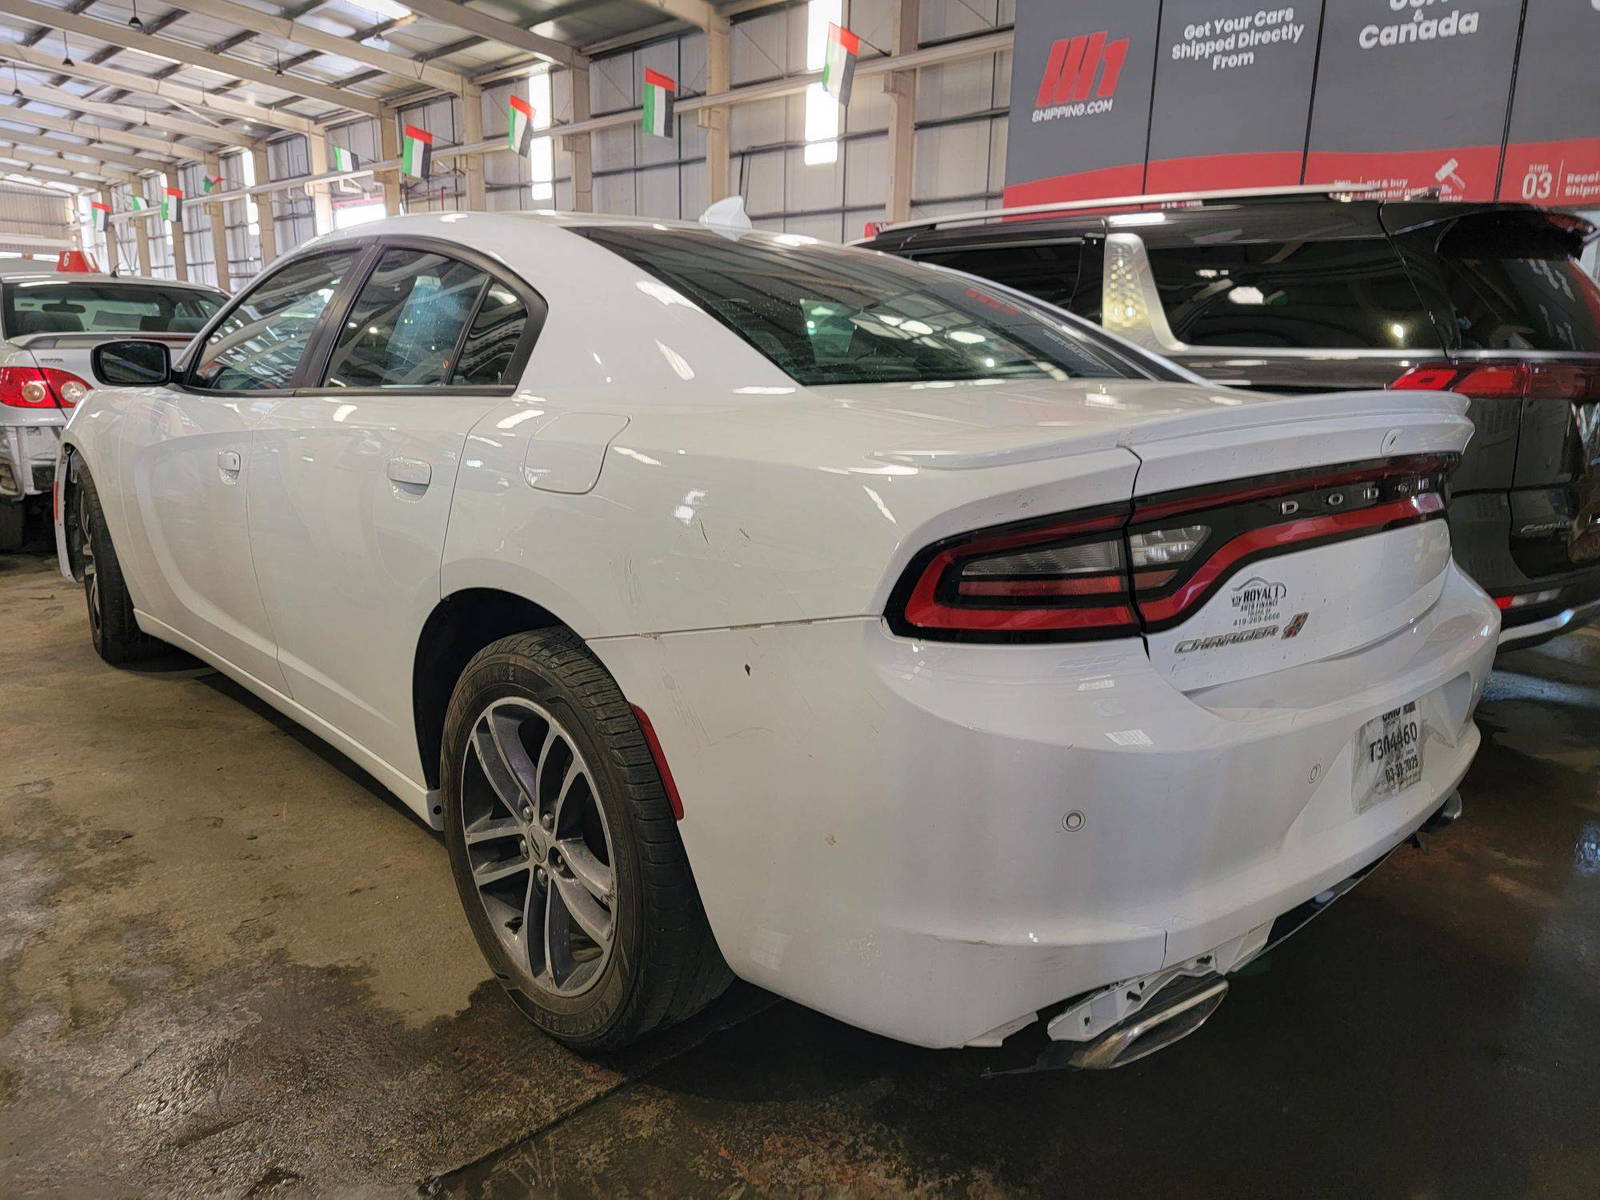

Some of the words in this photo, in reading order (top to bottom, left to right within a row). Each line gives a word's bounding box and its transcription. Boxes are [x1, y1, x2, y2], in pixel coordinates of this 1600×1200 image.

[1184, 22, 1211, 40] Get
[1214, 15, 1252, 34] Your
[1254, 7, 1294, 27] Cars
[1359, 10, 1479, 49] Canada
[1172, 33, 1236, 60] Shipped
[1238, 22, 1304, 48] Directly
[1212, 51, 1255, 71] From
[1031, 98, 1113, 122] SHIPPING.COM
[1522, 171, 1552, 200] 03
